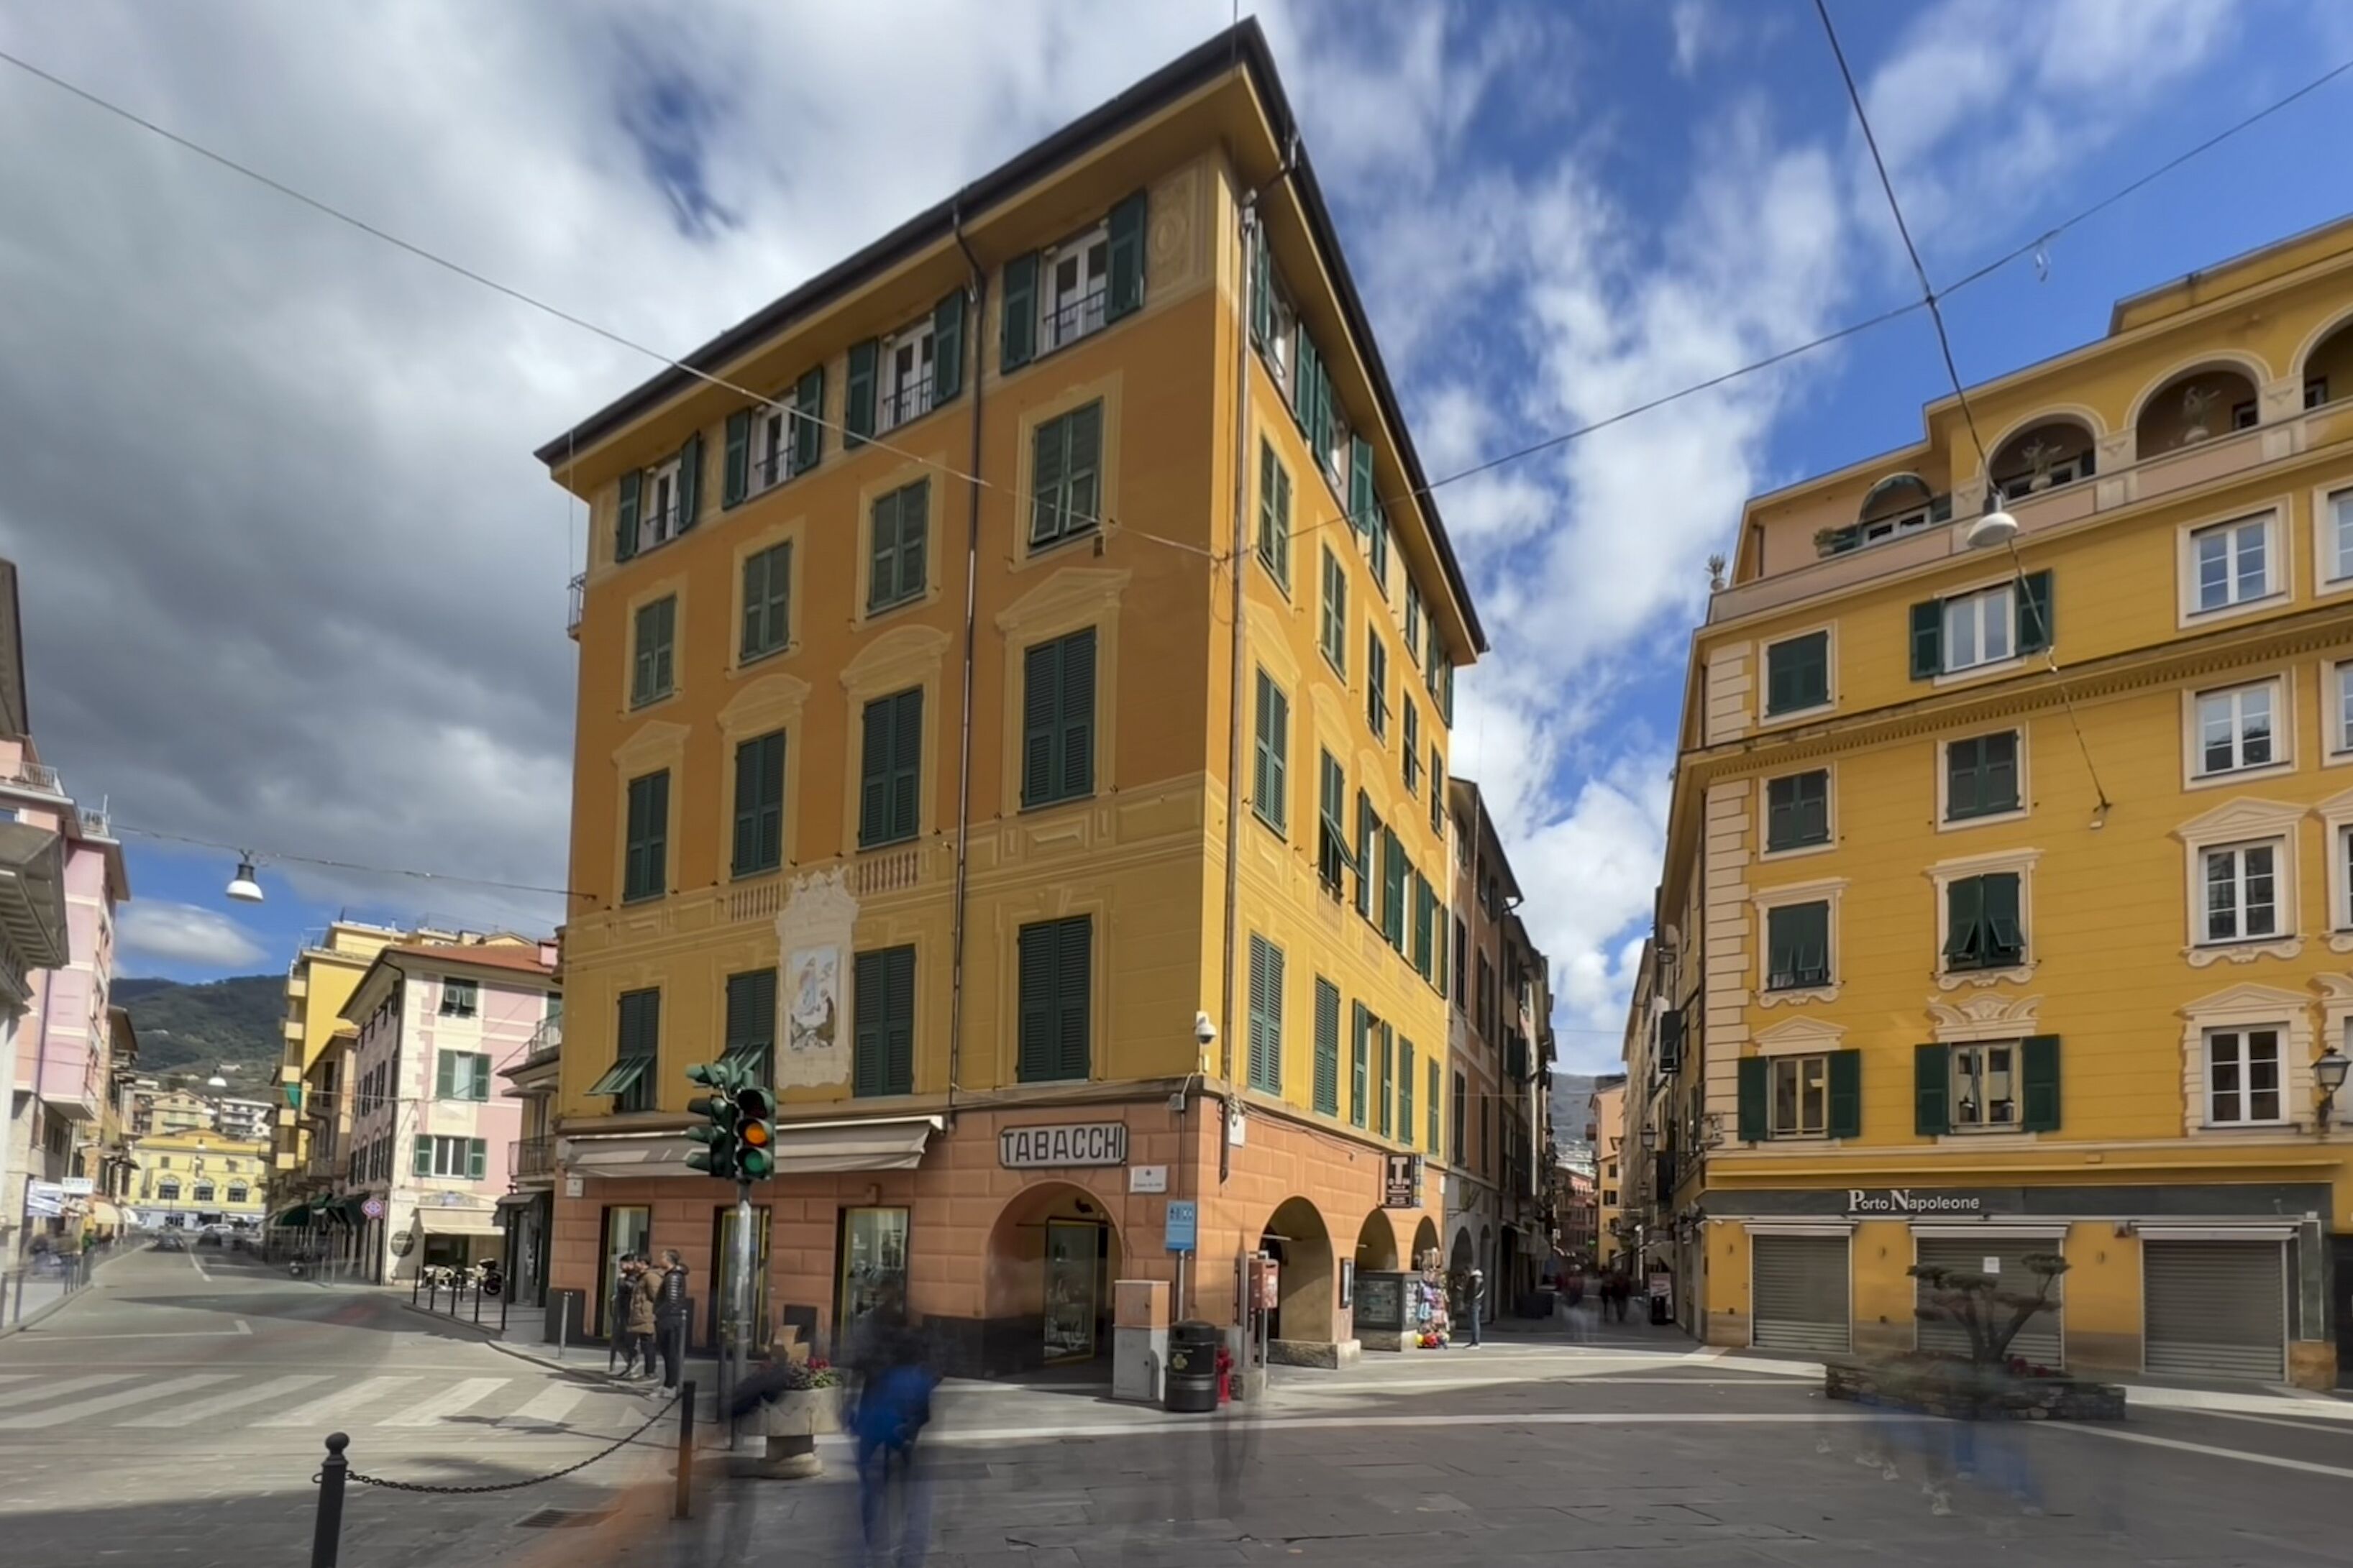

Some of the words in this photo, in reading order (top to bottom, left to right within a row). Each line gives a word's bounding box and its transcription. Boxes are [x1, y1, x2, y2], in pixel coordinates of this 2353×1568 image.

[1002, 1127, 1123, 1163] TABACCHI
[1390, 1156, 1408, 1185] T
[1847, 1188, 1889, 1211] Porto
[1889, 1188, 1980, 1213] Napoleone
